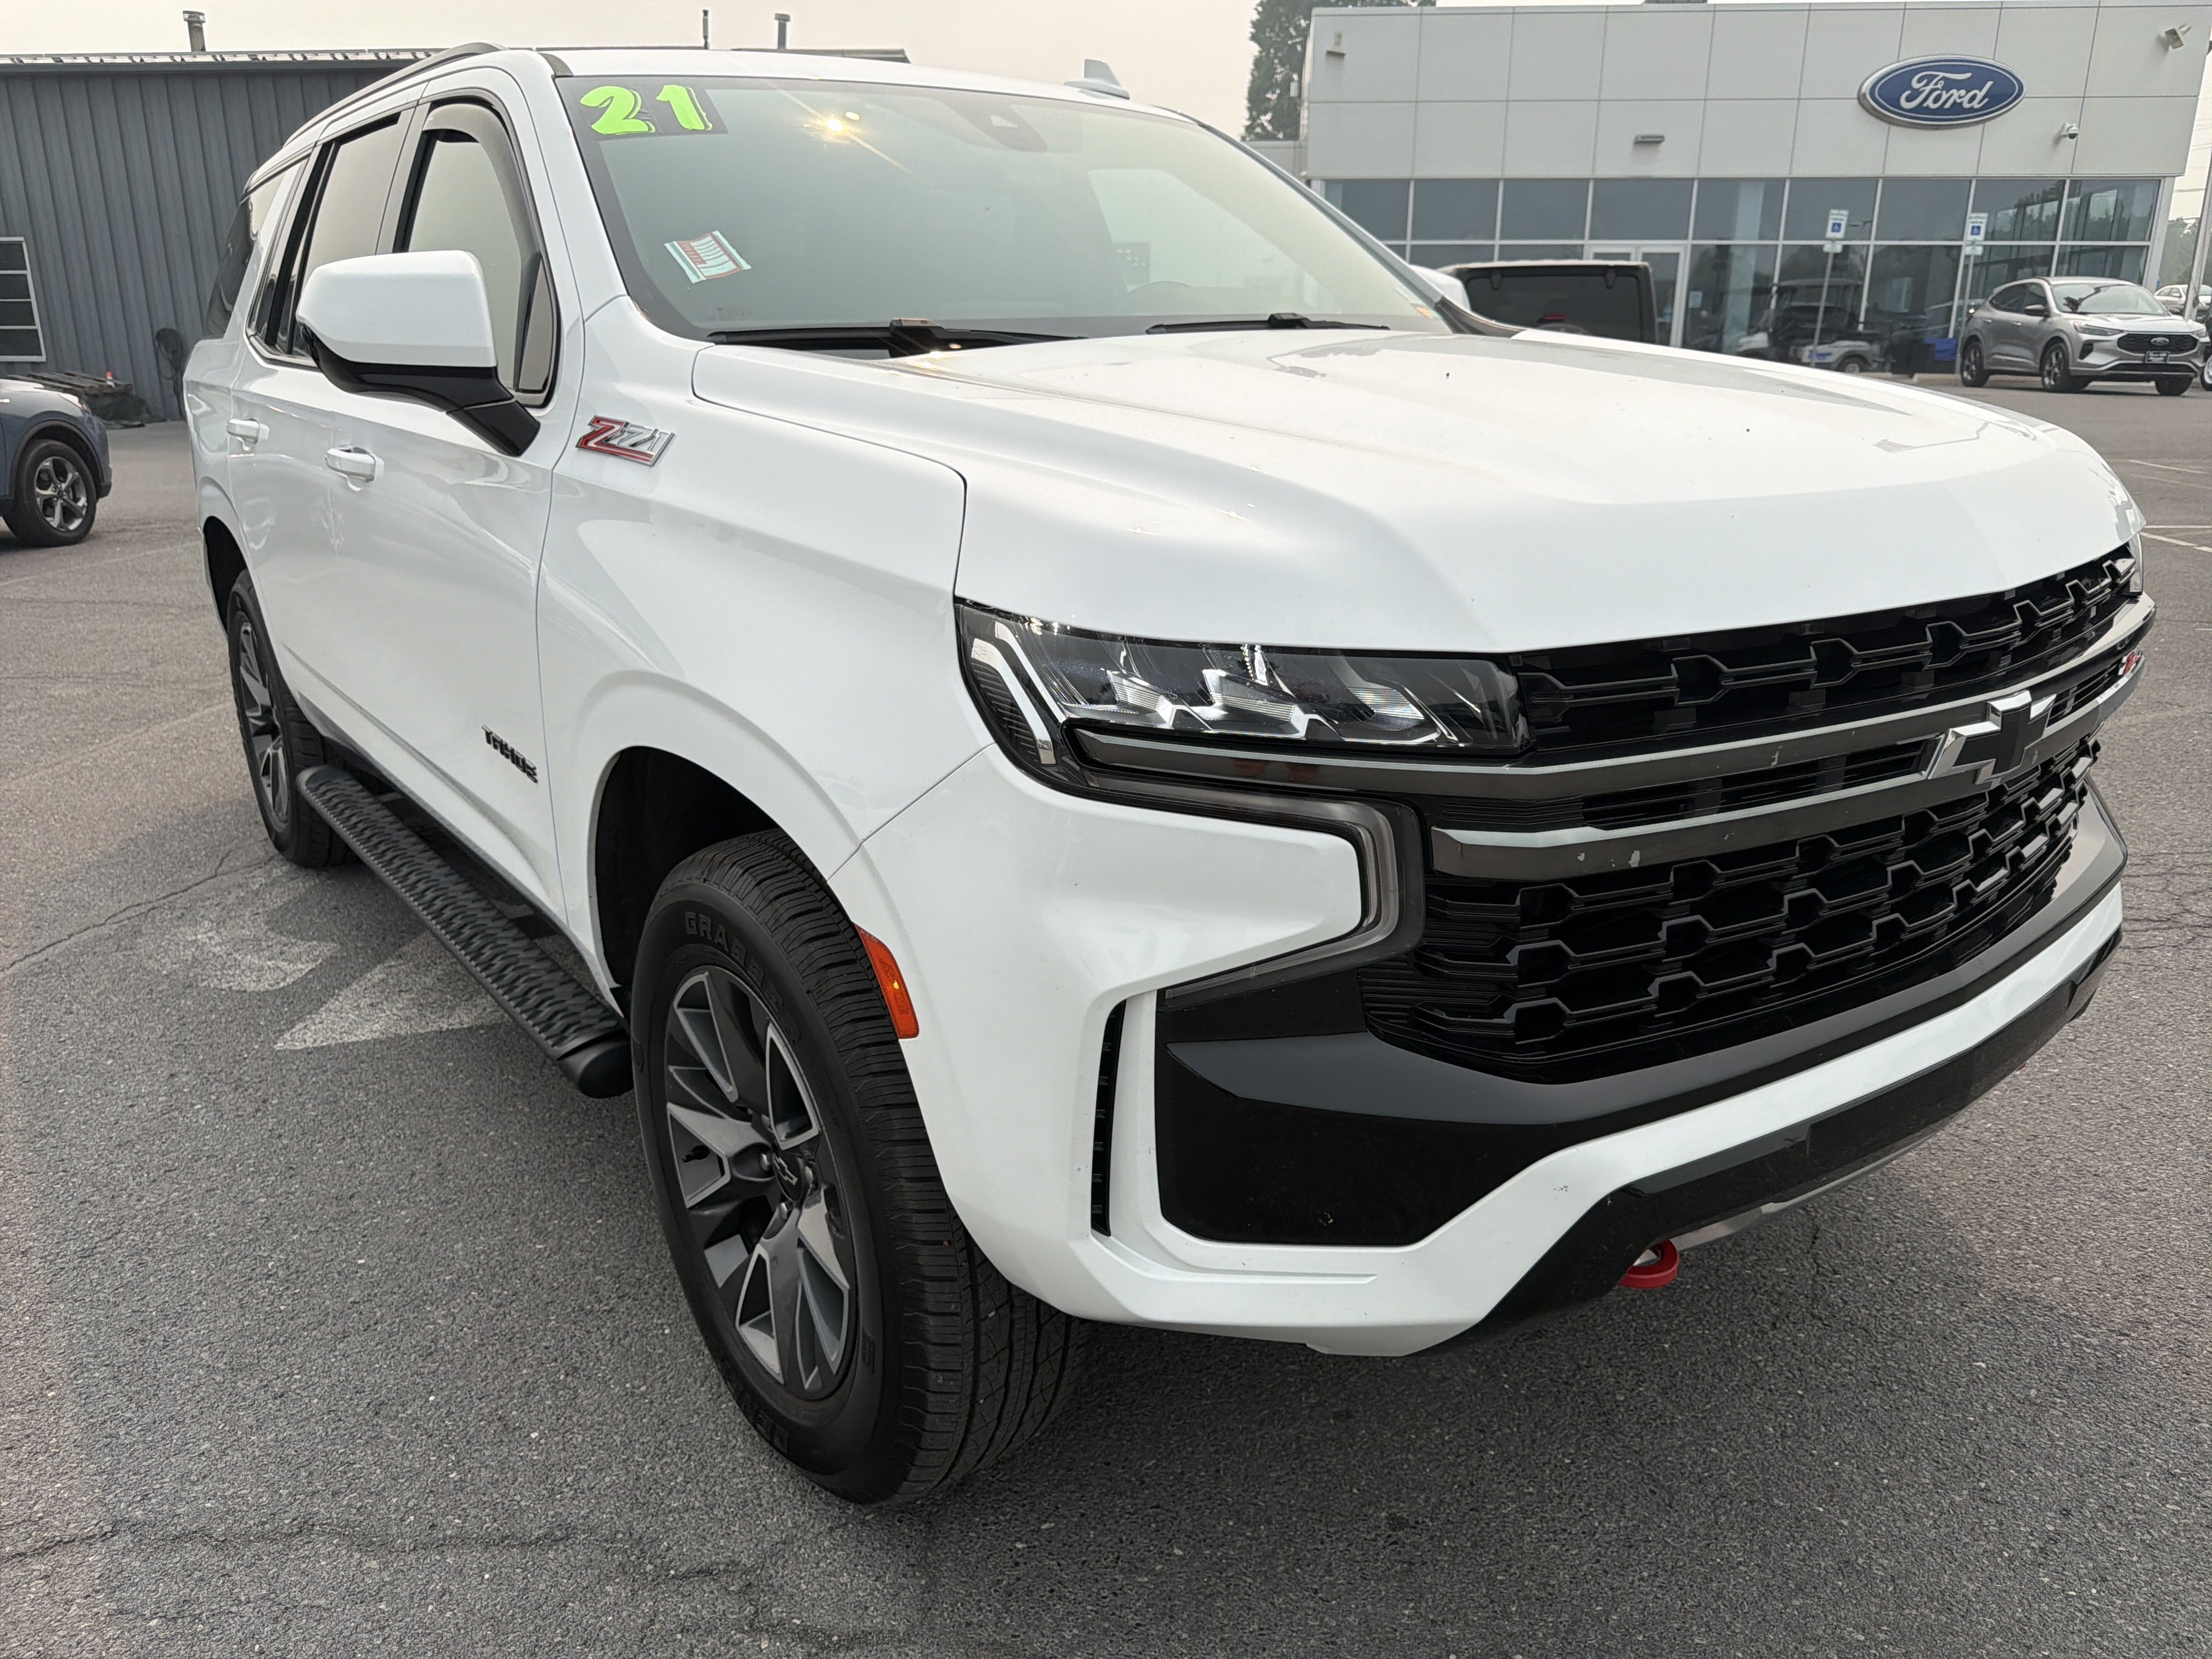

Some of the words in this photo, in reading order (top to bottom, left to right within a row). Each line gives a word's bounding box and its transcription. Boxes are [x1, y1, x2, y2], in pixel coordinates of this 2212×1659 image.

[579, 84, 713, 135] 21
[1900, 71, 1994, 109] Ford
[575, 415, 675, 467] Z71
[481, 724, 539, 784] TAHOE
